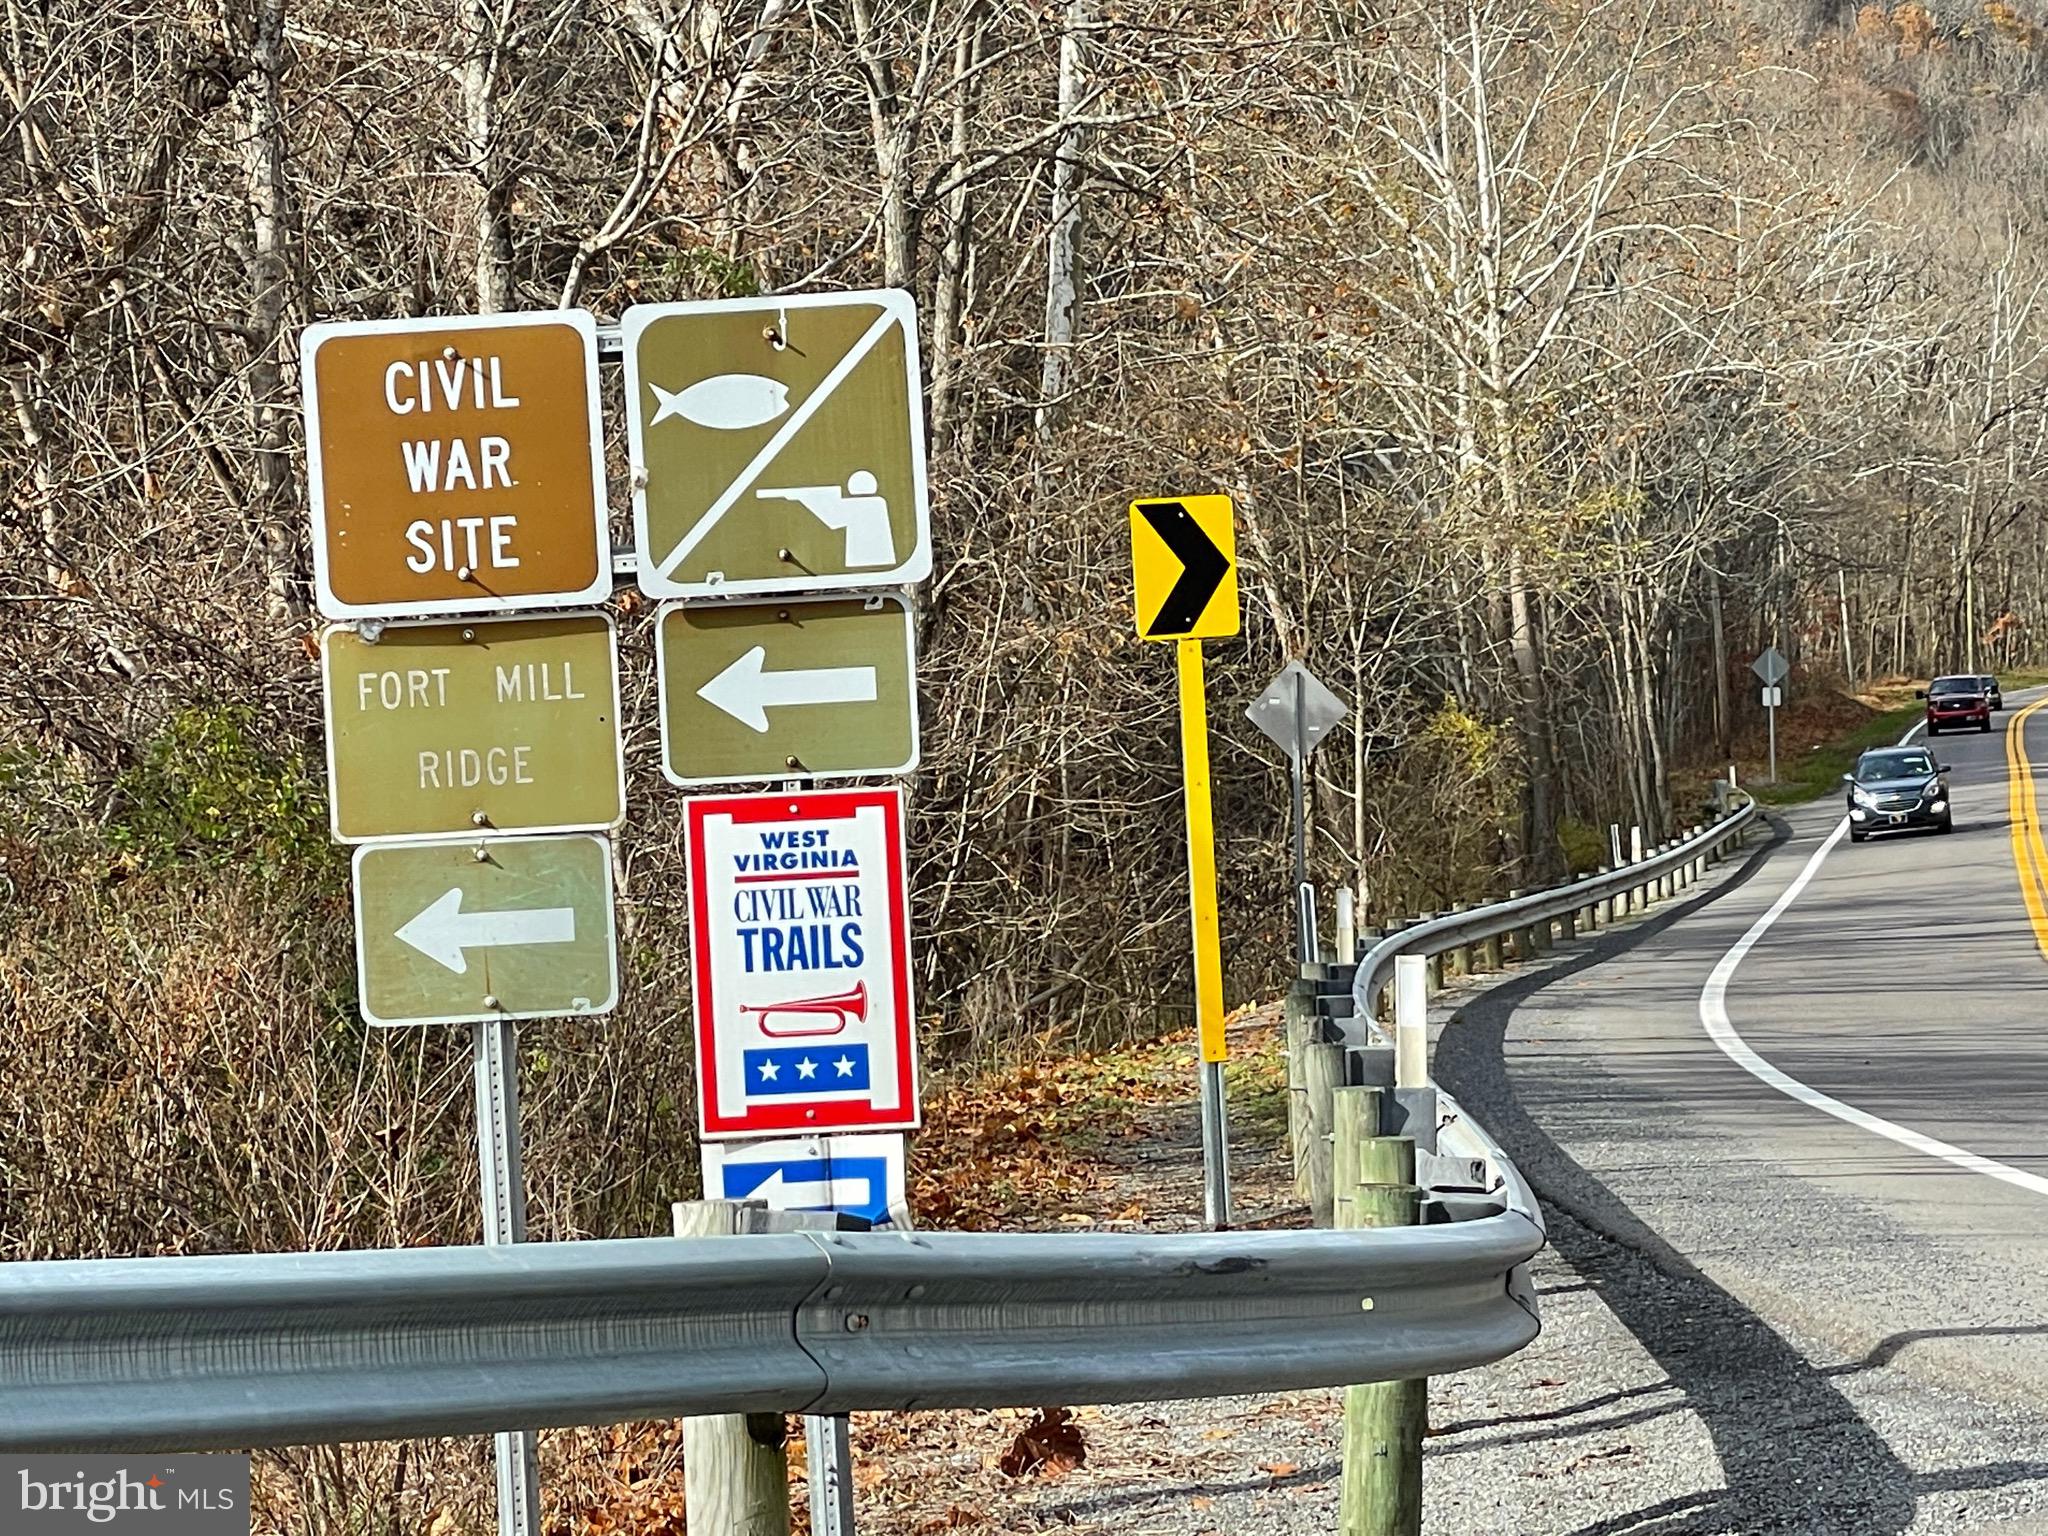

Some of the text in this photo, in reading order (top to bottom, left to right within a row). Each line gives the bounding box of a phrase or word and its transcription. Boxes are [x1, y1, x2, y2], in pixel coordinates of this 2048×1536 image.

[384, 357, 519, 415] CIVIL
[402, 437, 512, 493] WAR
[405, 516, 520, 573] SITE
[358, 661, 585, 710] FORT MILL
[418, 746, 534, 790] RIDGE
[734, 849, 858, 871] VIRGINIA
[759, 829, 830, 850] WEST
[733, 884, 863, 924] CIVIL WAR
[736, 921, 865, 973] TRAILS
